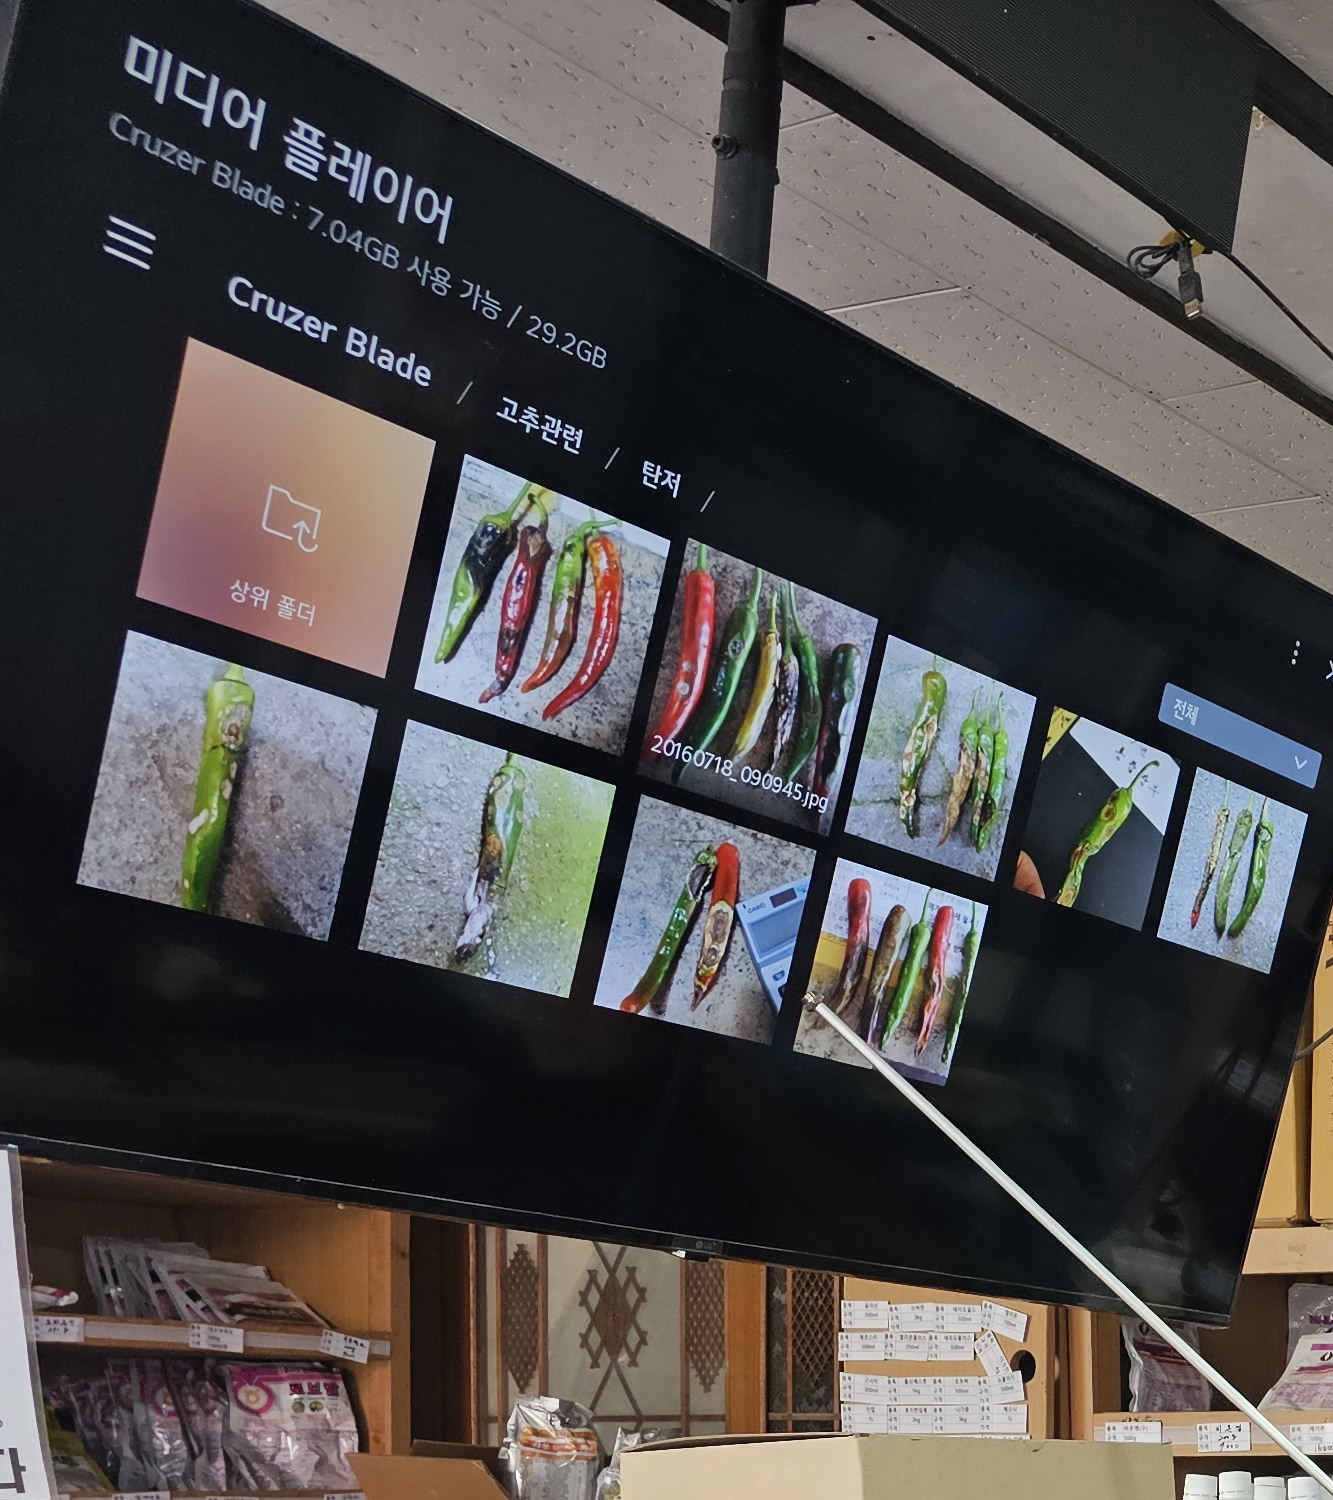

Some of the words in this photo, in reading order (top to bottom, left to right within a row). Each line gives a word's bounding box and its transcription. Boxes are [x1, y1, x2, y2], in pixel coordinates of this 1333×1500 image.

[124, 36, 266, 150] 미디어
[283, 117, 454, 244] 플레이어
[109, 111, 205, 176] Cruzer
[211, 160, 286, 215] Blade
[306, 206, 400, 271] 7.04GB
[406, 255, 452, 297] 사용
[459, 279, 502, 322] 가능
[525, 314, 608, 370] 29.2GB
[226, 274, 338, 344] Cruzer
[345, 327, 433, 388] Blade
[497, 395, 584, 455] 고추관련
[642, 459, 682, 499] 탄저
[229, 579, 270, 611] 상위
[277, 595, 316, 627] 폴더
[650, 733, 830, 815] 20160718_090945.jpg
[1172, 697, 1199, 727] 전체
